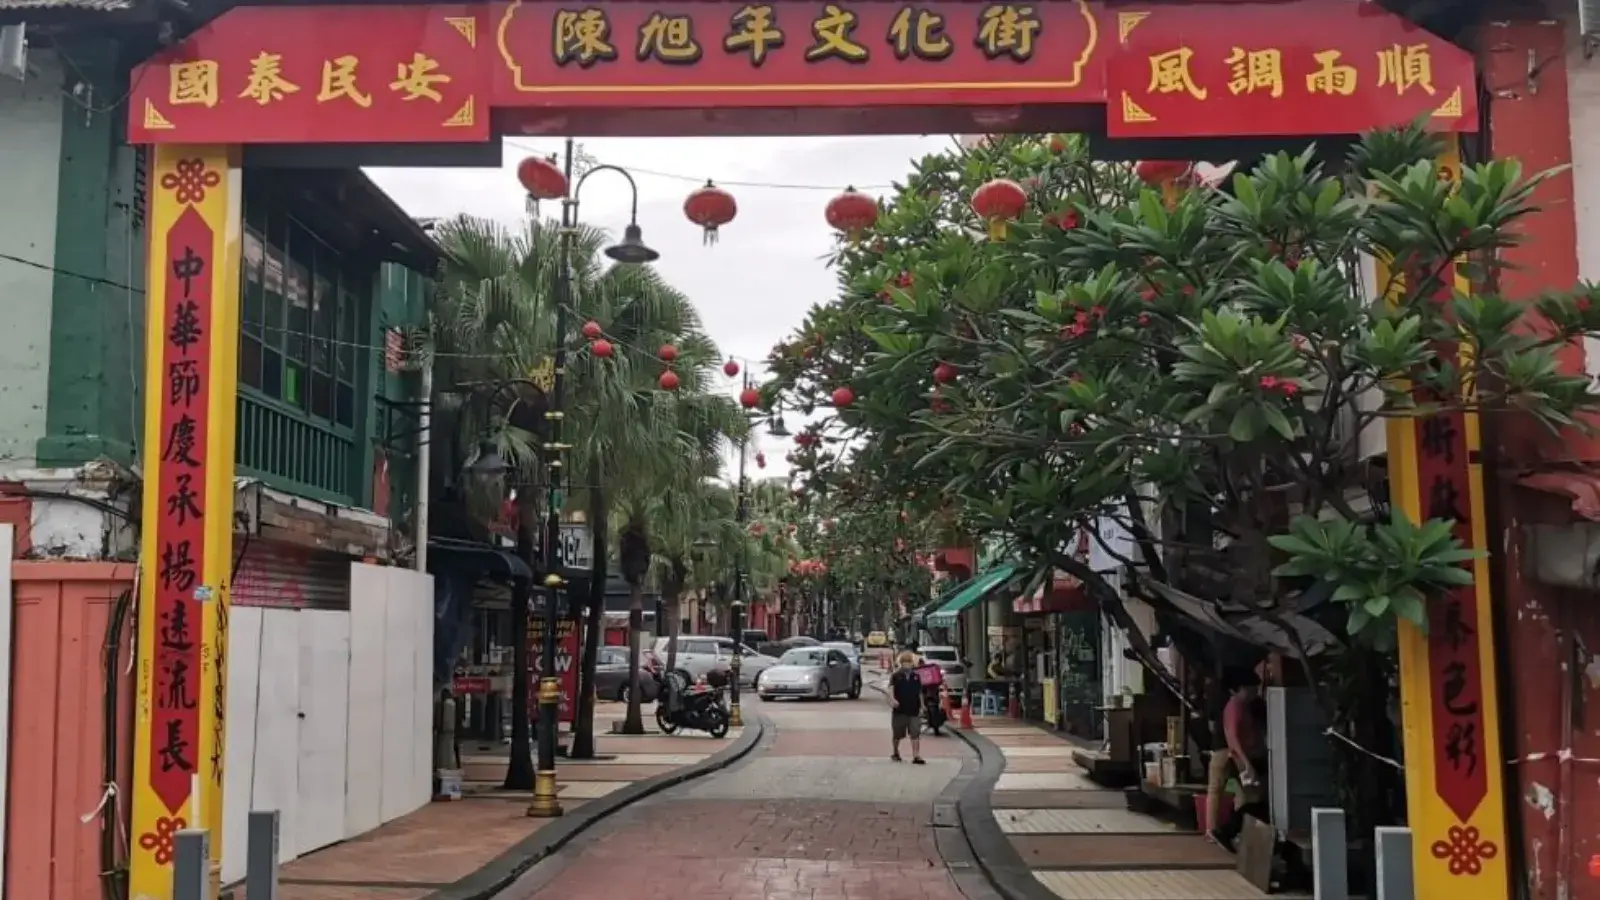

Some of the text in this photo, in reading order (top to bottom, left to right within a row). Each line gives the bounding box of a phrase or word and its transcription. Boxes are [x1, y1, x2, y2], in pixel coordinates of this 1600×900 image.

[553, 4, 1041, 65] 陳旭年文化街
[169, 50, 452, 108] 國泰民安
[1146, 43, 1437, 101] 風調雨順
[158, 245, 205, 774] 中華節慶承揚遠流長
